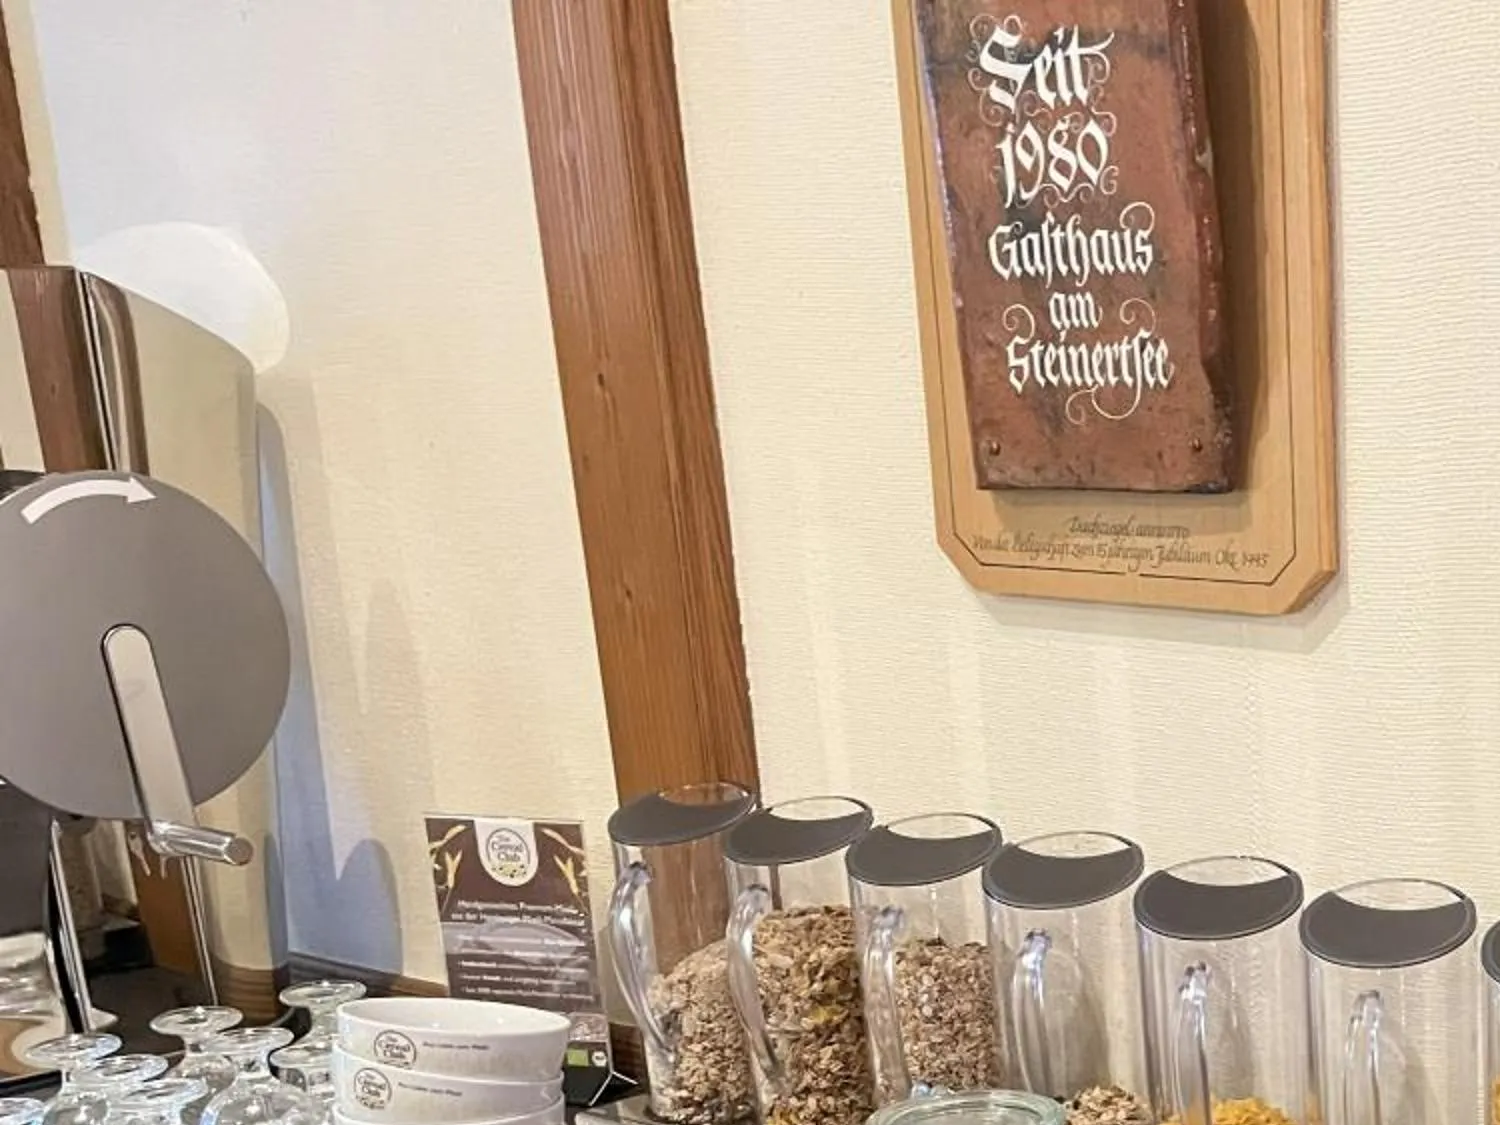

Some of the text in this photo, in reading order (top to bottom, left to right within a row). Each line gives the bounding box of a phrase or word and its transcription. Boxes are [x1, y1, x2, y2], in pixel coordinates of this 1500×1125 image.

[971, 18, 1114, 117] Seit
[993, 114, 1114, 208] 1980
[1048, 290, 1102, 330] am
